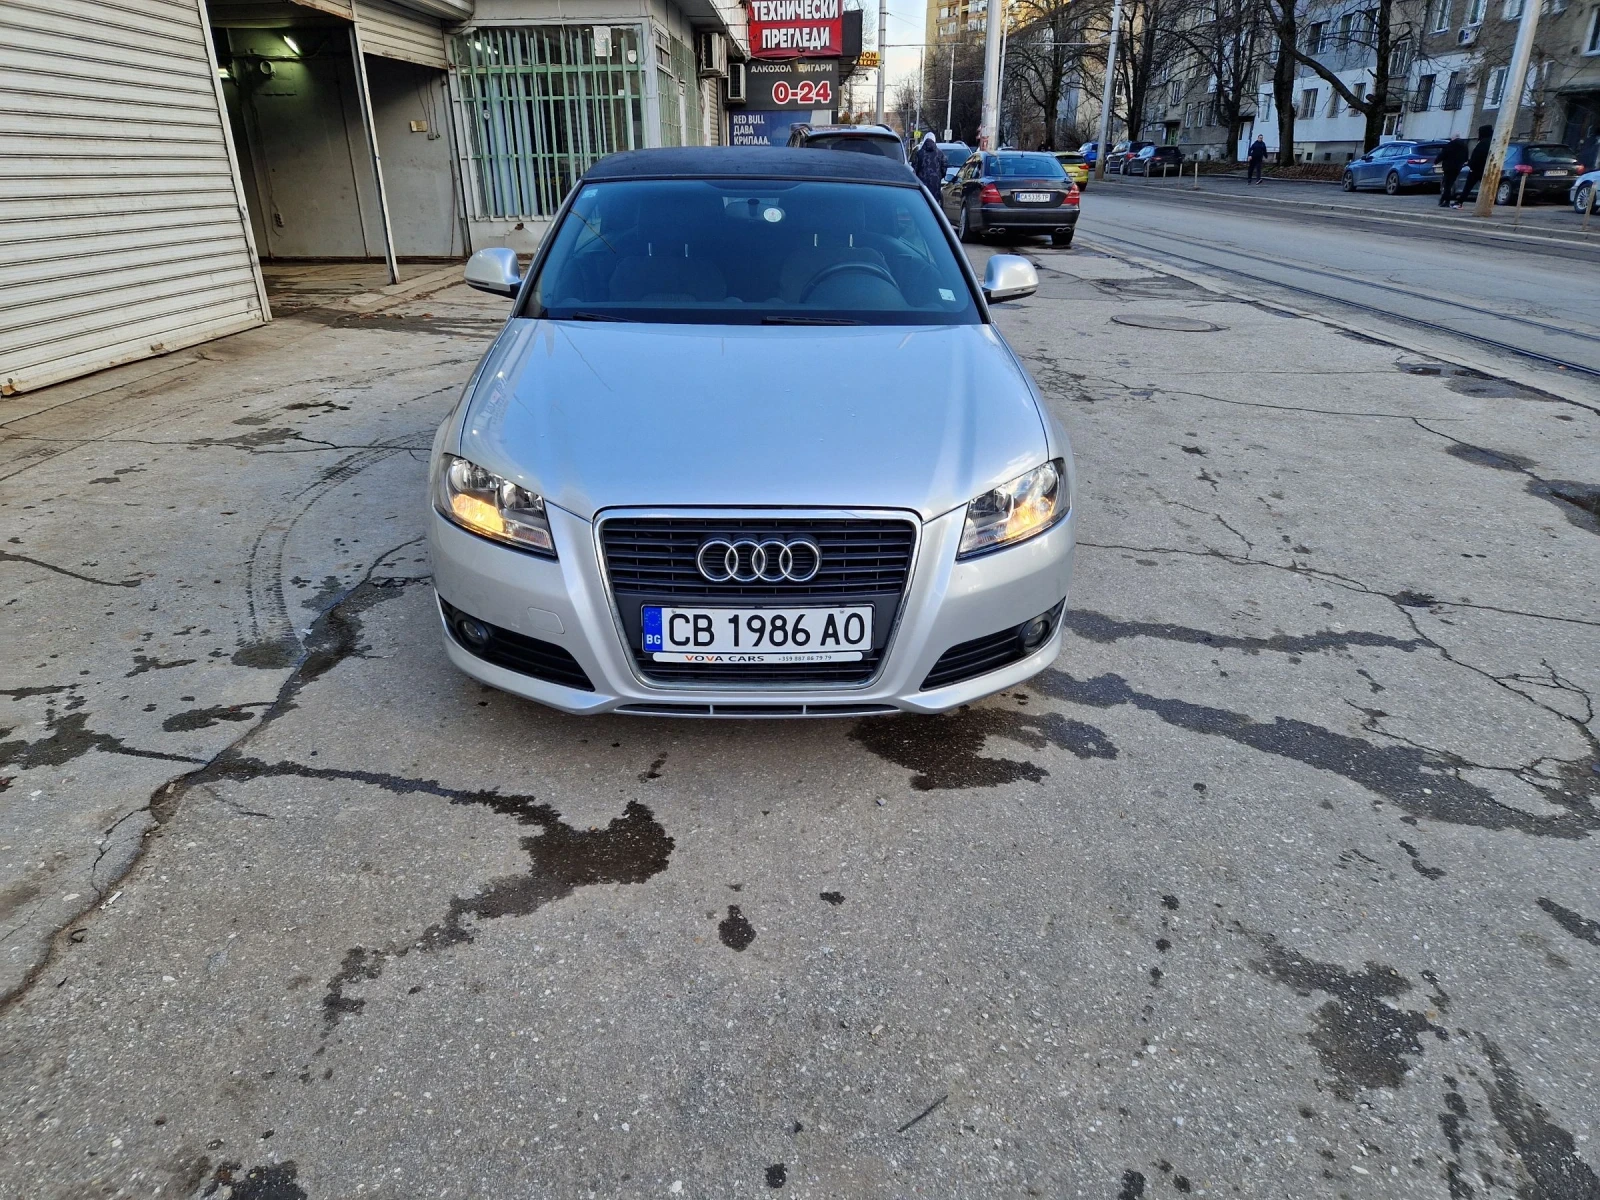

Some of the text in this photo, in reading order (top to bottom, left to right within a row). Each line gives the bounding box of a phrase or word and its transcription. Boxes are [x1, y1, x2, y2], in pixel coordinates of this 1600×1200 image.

[752, 0, 838, 20] ТЕХНИЧЕСКИ
[762, 27, 829, 50] ПРЕГЛЕДИ
[751, 64, 832, 73] АЛКОХОЛ ЦИГАРИ
[772, 81, 831, 104] 0-24
[733, 115, 764, 124] RED BULL
[733, 125, 754, 134] ДАВА
[734, 136, 770, 145] КРИЛААА.
[668, 613, 715, 647] CB
[728, 614, 811, 647] 1986
[646, 634, 661, 644] BG
